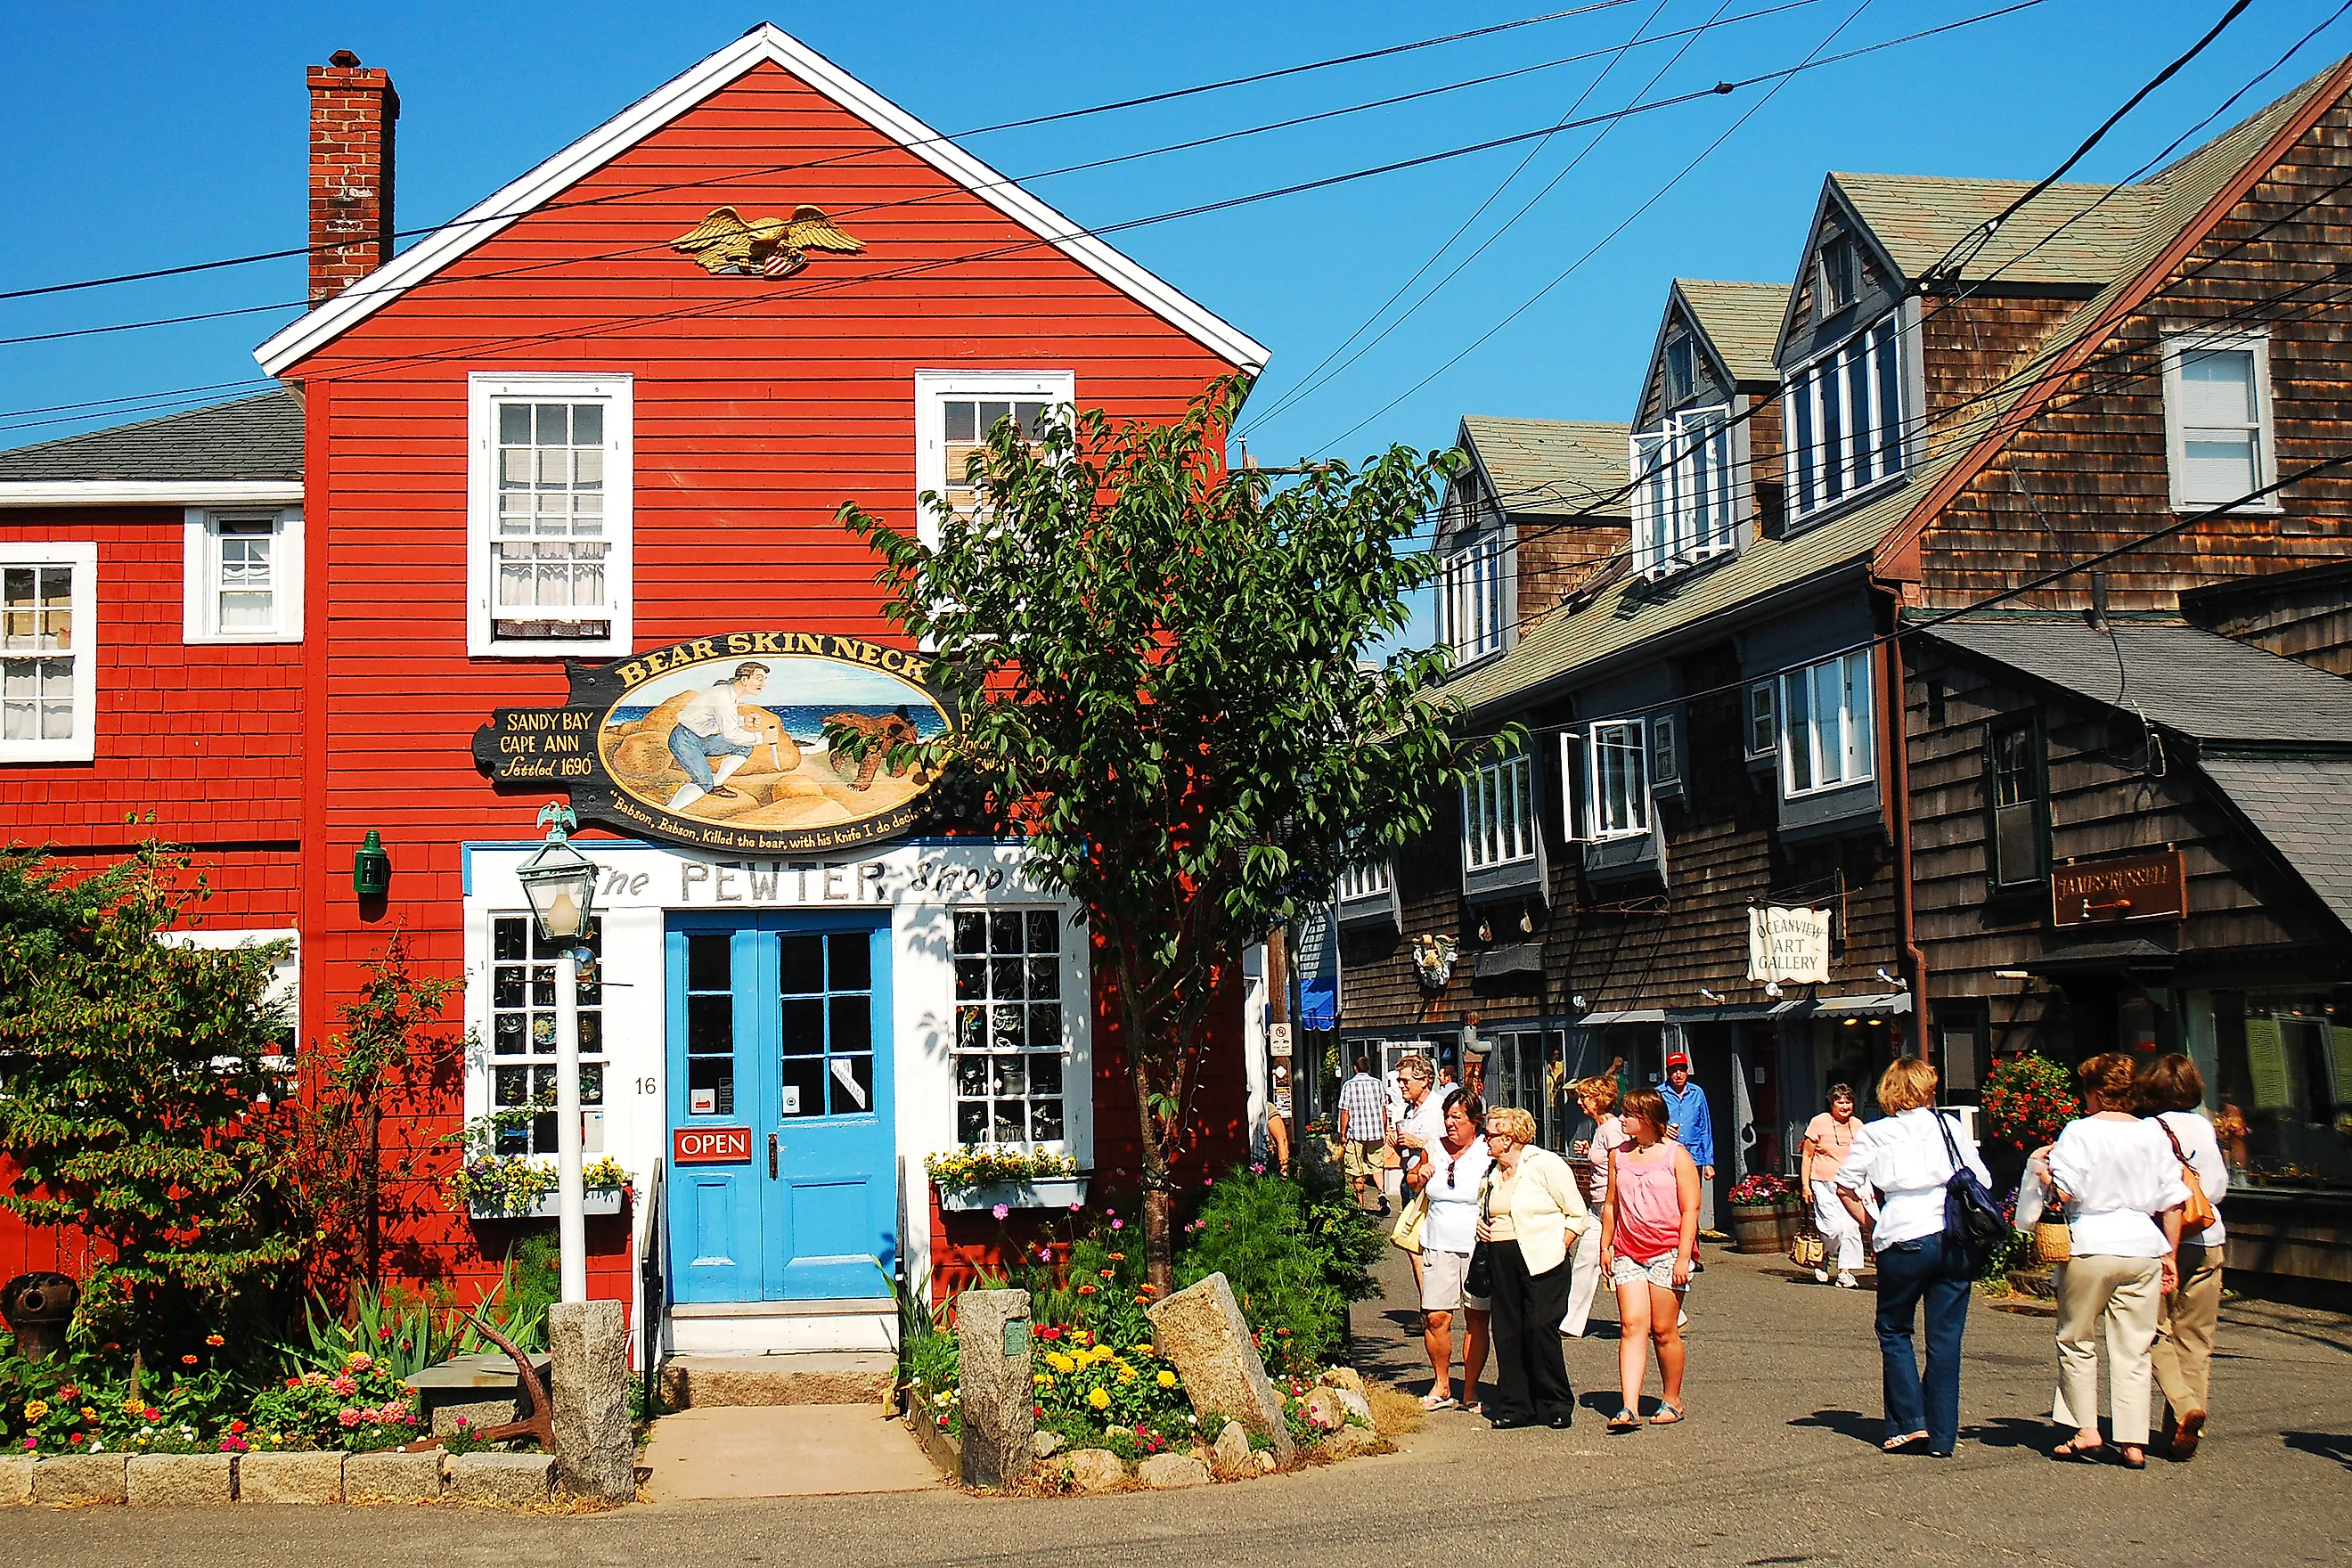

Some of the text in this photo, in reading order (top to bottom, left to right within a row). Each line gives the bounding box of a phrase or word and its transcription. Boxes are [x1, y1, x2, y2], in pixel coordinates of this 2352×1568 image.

[615, 633, 932, 689] BEAR SKIN NECK
[507, 712, 594, 731] SANDY BAY
[500, 734, 580, 754] CAPE ANN
[500, 755, 592, 777] Settled 1690
[657, 817, 701, 843] Babson,
[736, 835, 755, 848] the
[758, 835, 788, 851] bear,
[788, 836, 816, 849] with
[816, 832, 832, 847] his
[862, 823, 874, 838] I
[876, 820, 891, 835] do
[682, 862, 890, 902] PEWTER
[911, 861, 1004, 893] Shop
[2057, 864, 2172, 901] JAMES RUSSELL
[1757, 919, 1825, 940] OCEANVIEW
[1773, 938, 1805, 953] ART
[1758, 955, 1818, 970] GALLERY
[635, 1076, 657, 1095] 16
[681, 1134, 745, 1155] OPEN
